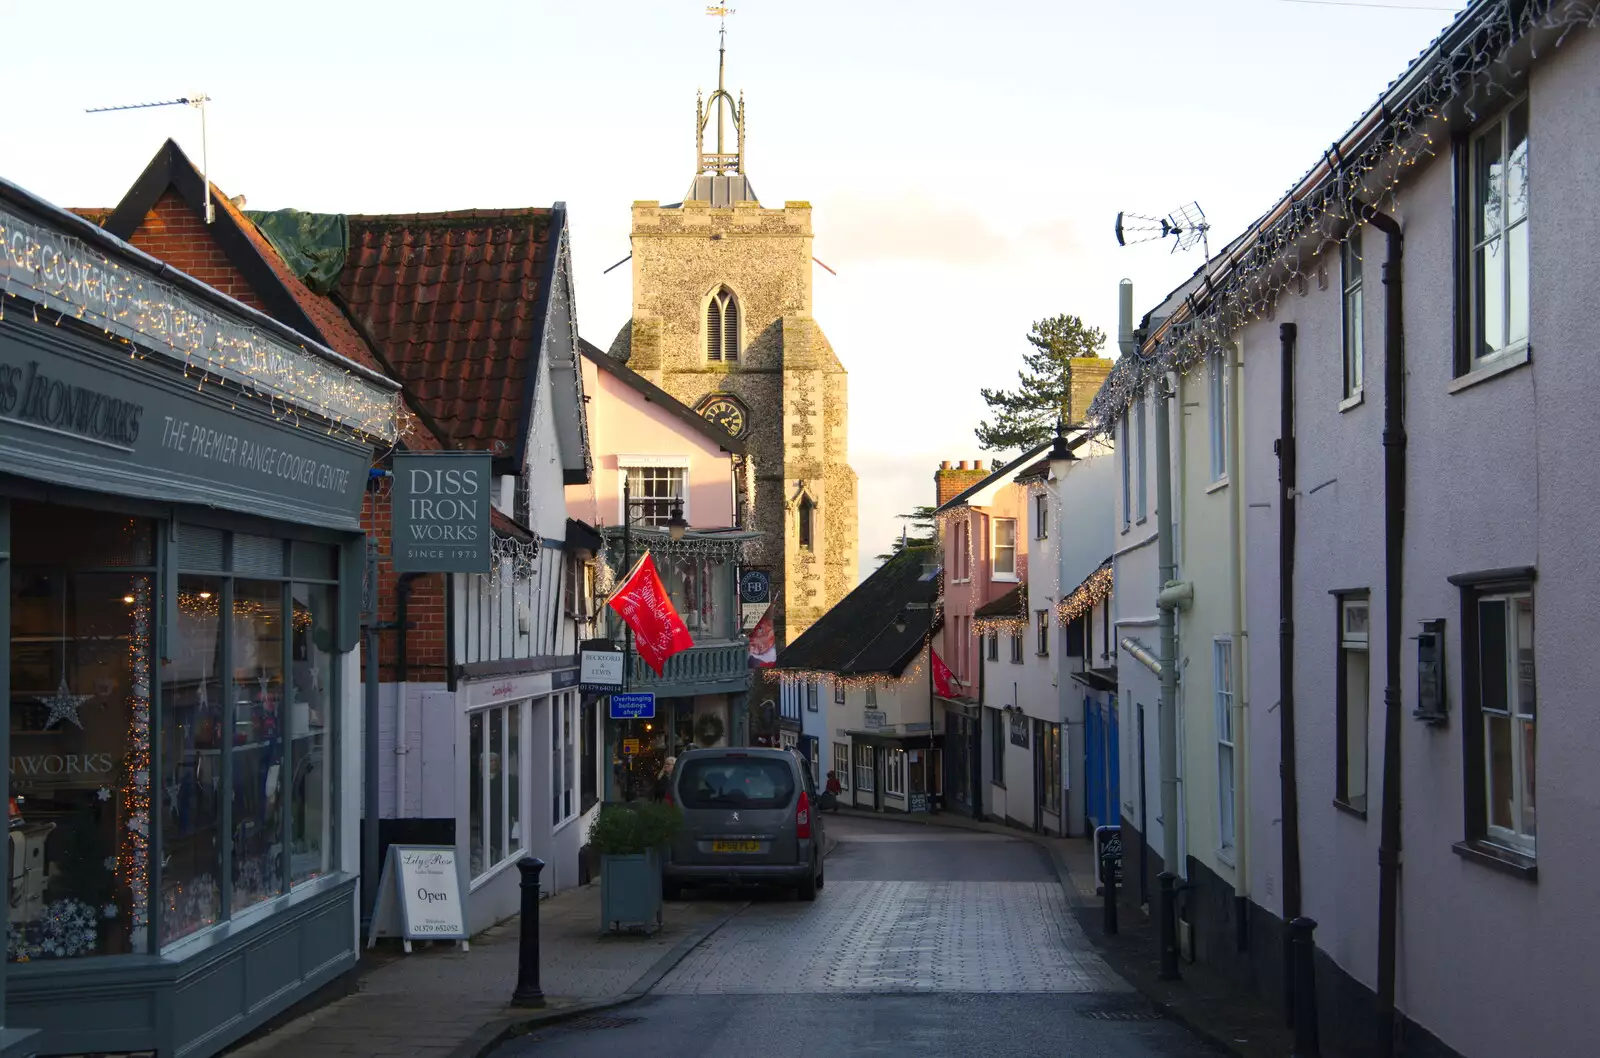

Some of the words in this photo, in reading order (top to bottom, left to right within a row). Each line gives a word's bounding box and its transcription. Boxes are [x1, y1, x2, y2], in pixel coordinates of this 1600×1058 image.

[18, 360, 145, 444] IRONWORKS
[161, 416, 189, 452] THE
[188, 424, 239, 467] PREMIER
[239, 439, 276, 475] RANGE
[276, 451, 316, 486] COOKER
[316, 463, 350, 494] CENTRE
[408, 469, 478, 495] DISS
[409, 499, 478, 520] IRON
[409, 525, 478, 540] WORKS
[408, 550, 444, 558] SINCE
[452, 550, 477, 558] 1973
[613, 695, 652, 703] Overhanging
[618, 702, 647, 710] buildings
[403, 854, 424, 869] Lily
[417, 888, 447, 903] Open
